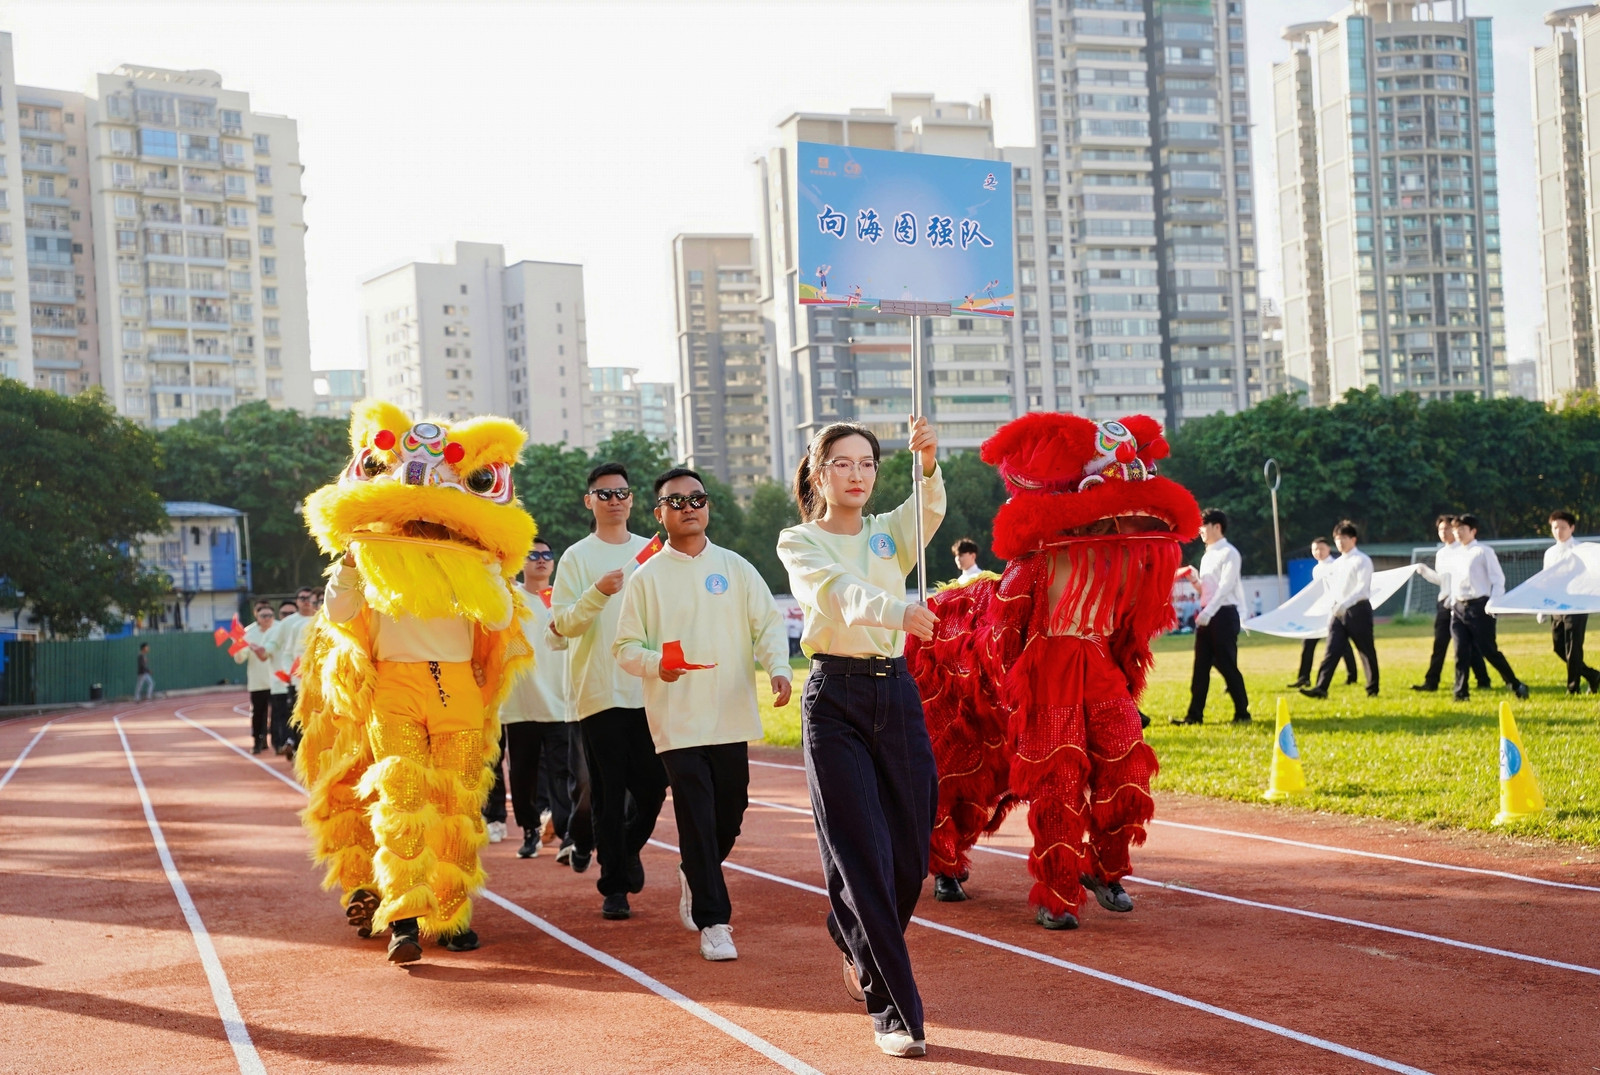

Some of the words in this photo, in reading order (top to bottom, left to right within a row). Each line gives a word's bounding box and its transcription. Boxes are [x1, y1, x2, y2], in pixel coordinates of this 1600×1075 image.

[818, 205, 993, 249] 向海图强队
